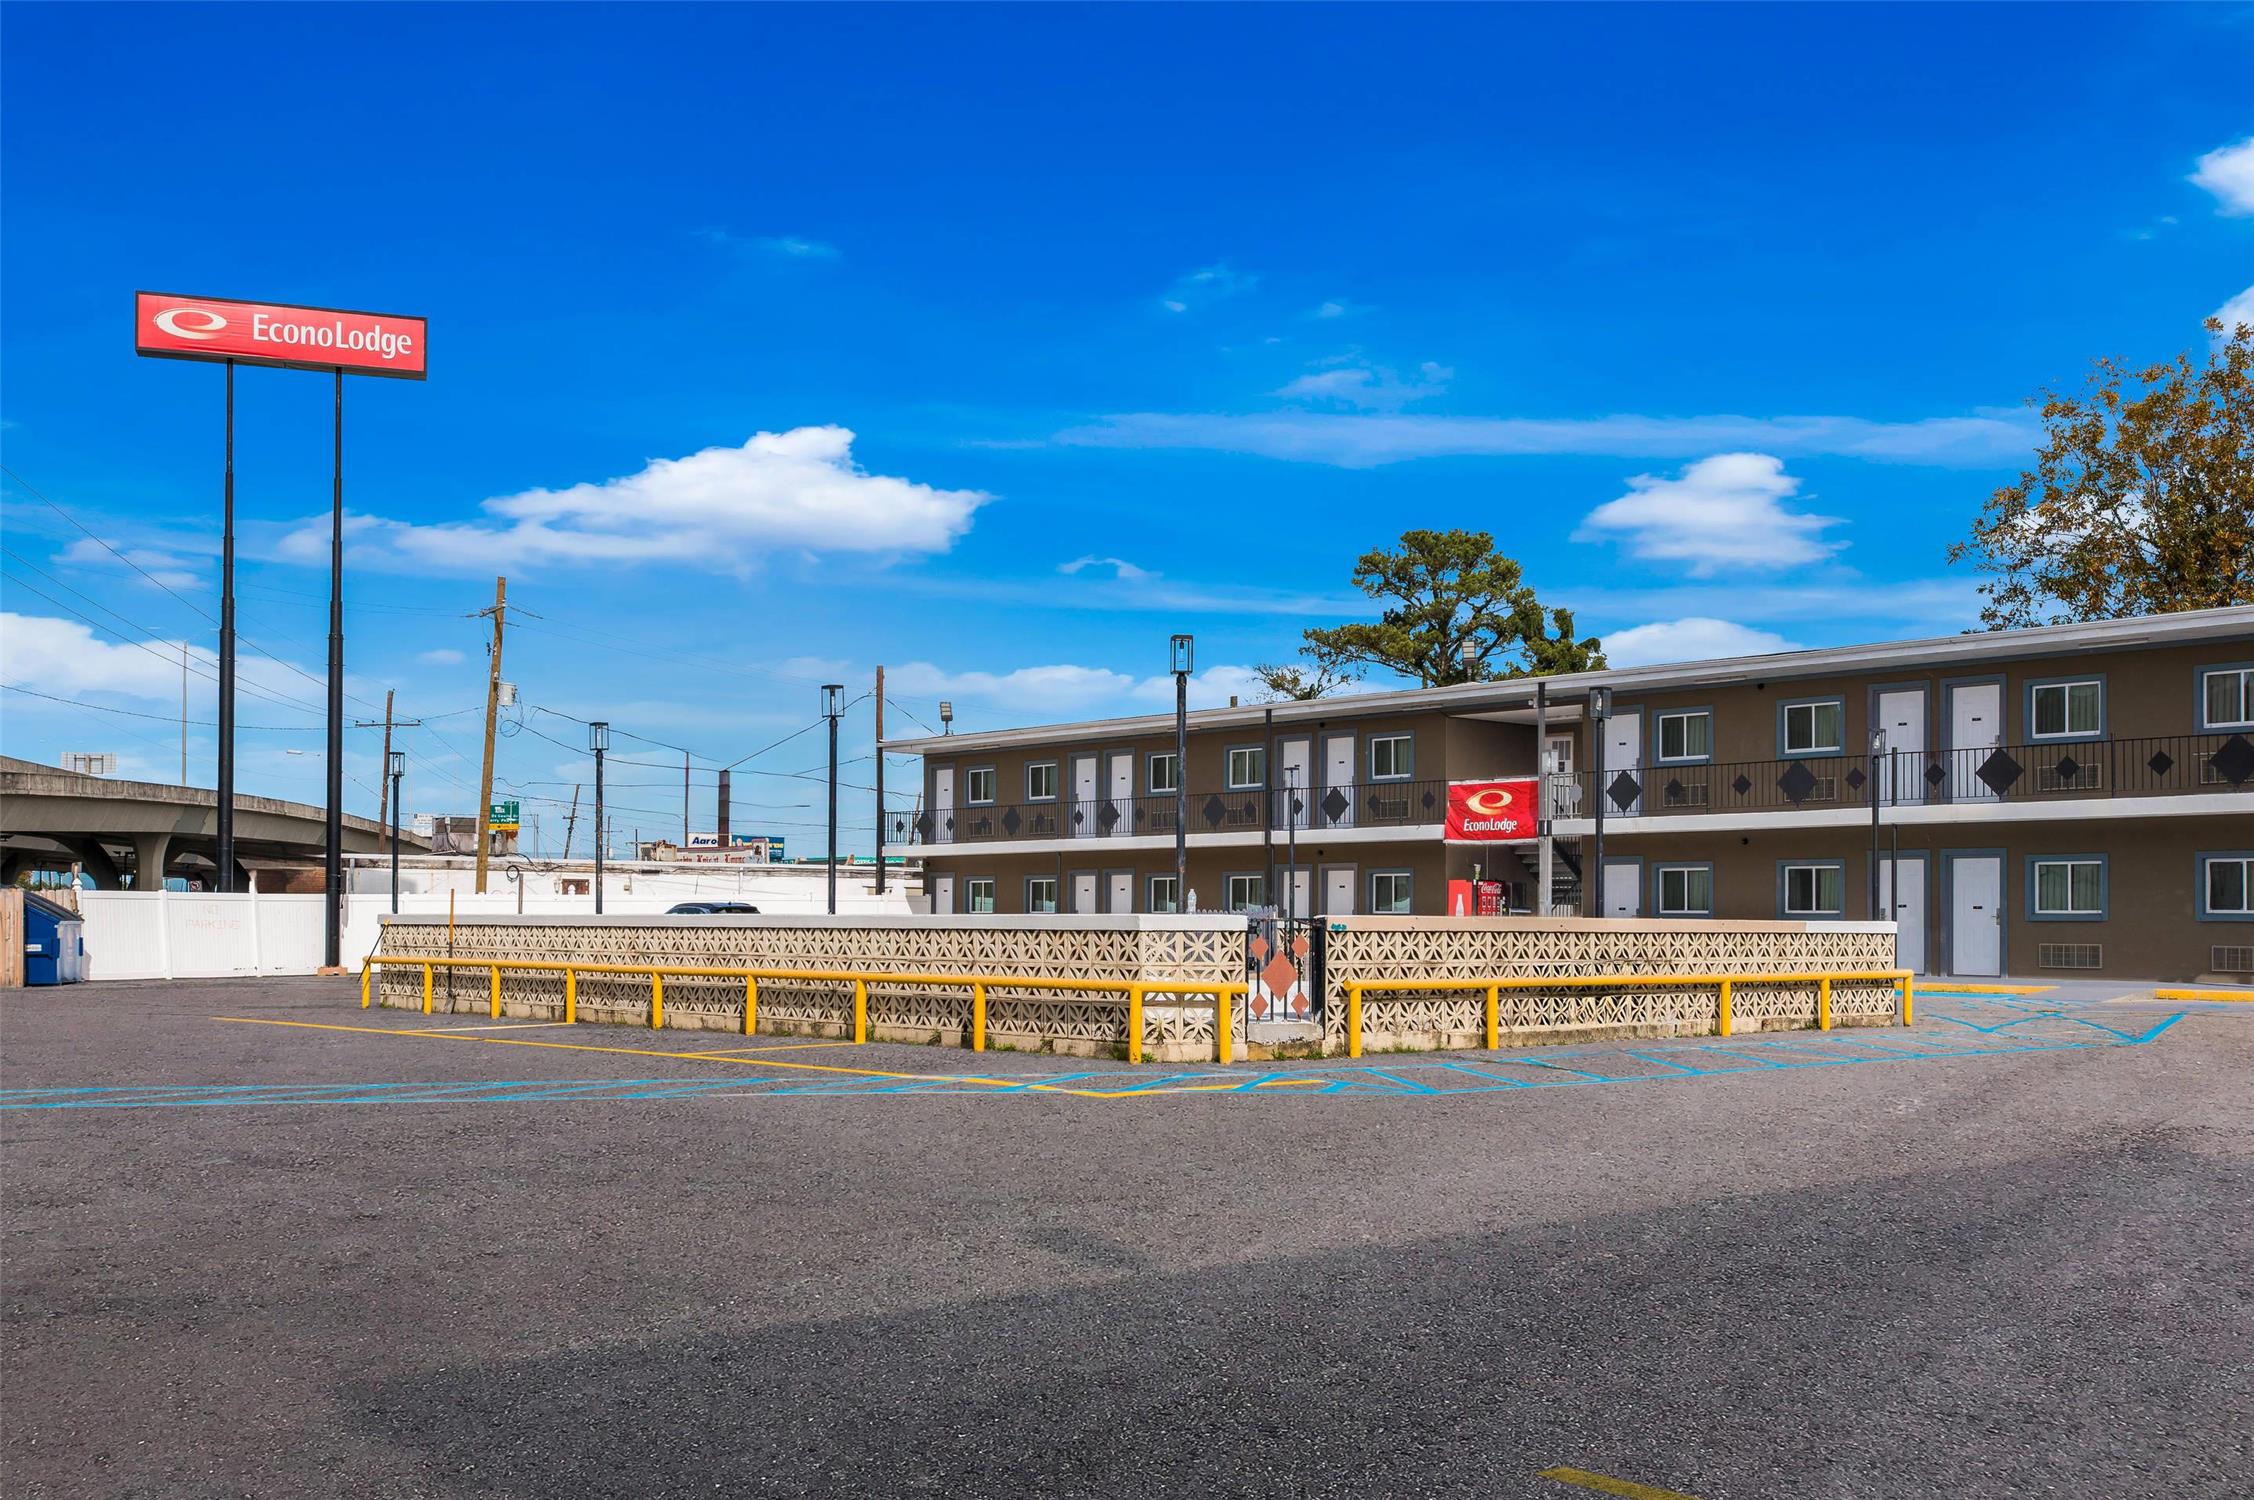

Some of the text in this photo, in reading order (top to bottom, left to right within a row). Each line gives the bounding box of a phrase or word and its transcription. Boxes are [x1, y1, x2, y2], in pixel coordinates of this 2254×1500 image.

[253, 312, 412, 359] EconoLodge
[1463, 817, 1518, 834] EconoLodge
[692, 836, 719, 845] Aaro
